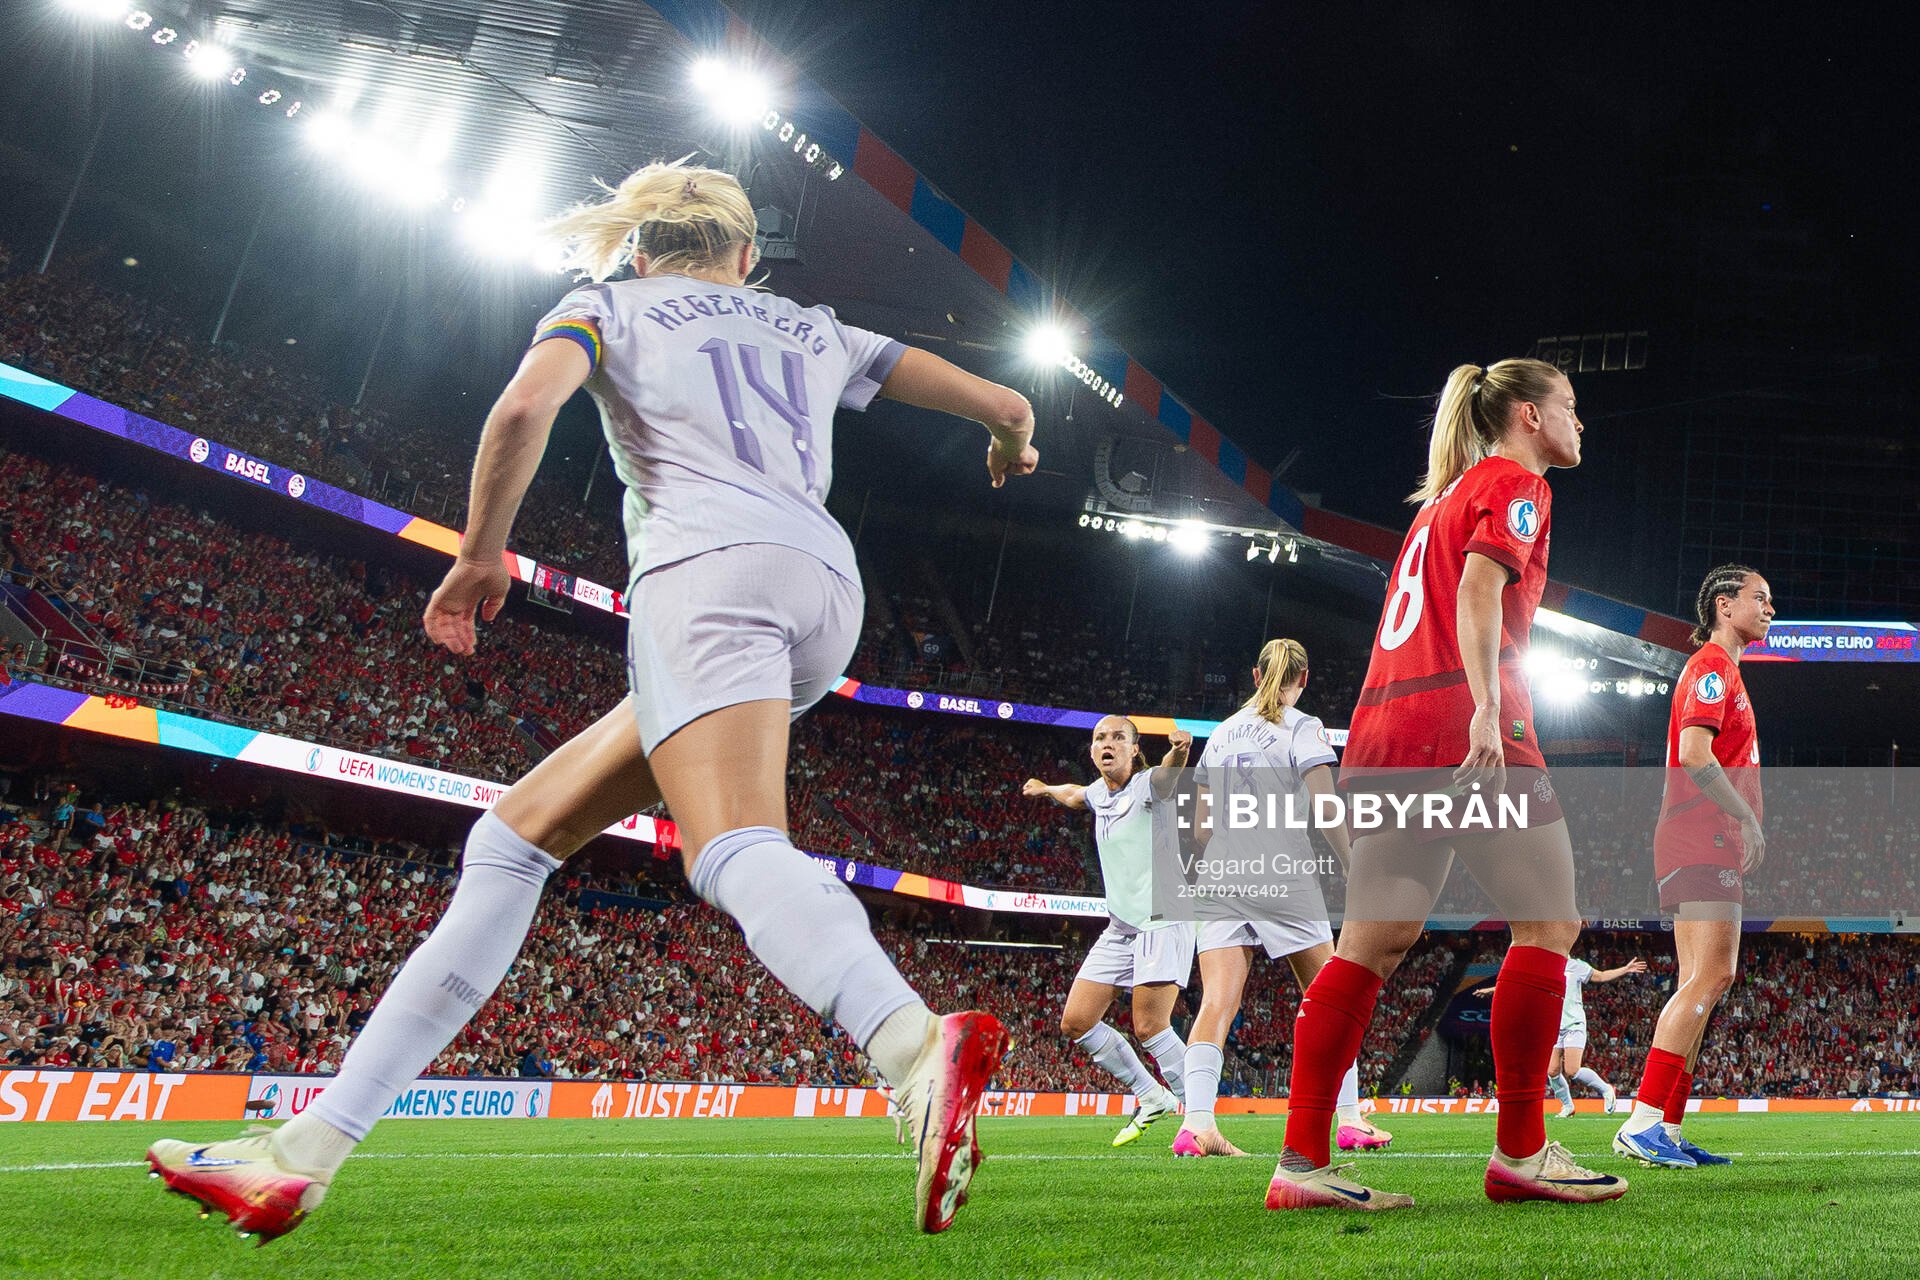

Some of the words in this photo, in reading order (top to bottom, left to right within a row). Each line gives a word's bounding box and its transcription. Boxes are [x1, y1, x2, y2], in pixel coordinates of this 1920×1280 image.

[644, 293, 830, 357] HEGERBERG
[697, 337, 817, 495] 14
[224, 452, 271, 484] BASEL
[1379, 525, 1431, 651] 8
[1768, 635, 1834, 649] WOMEN'S
[1836, 636, 1874, 649] EURO
[939, 697, 981, 714] BASEL
[339, 756, 374, 780] UEFA
[376, 764, 435, 791] WOMEN'S
[439, 778, 471, 798] EURO
[1014, 896, 1047, 909] UEFA
[1049, 899, 1107, 913] WOMEN'S
[1602, 918, 1644, 929] BASEL
[77, 1072, 188, 1121] EAT
[384, 1088, 458, 1117] MEN'S
[461, 1091, 514, 1117] EURO
[621, 1083, 692, 1118] JUST
[692, 1085, 745, 1118] EAT
[1004, 1091, 1036, 1117] EAT
[1388, 1098, 1459, 1113] JUST
[1464, 1098, 1500, 1113] EA
